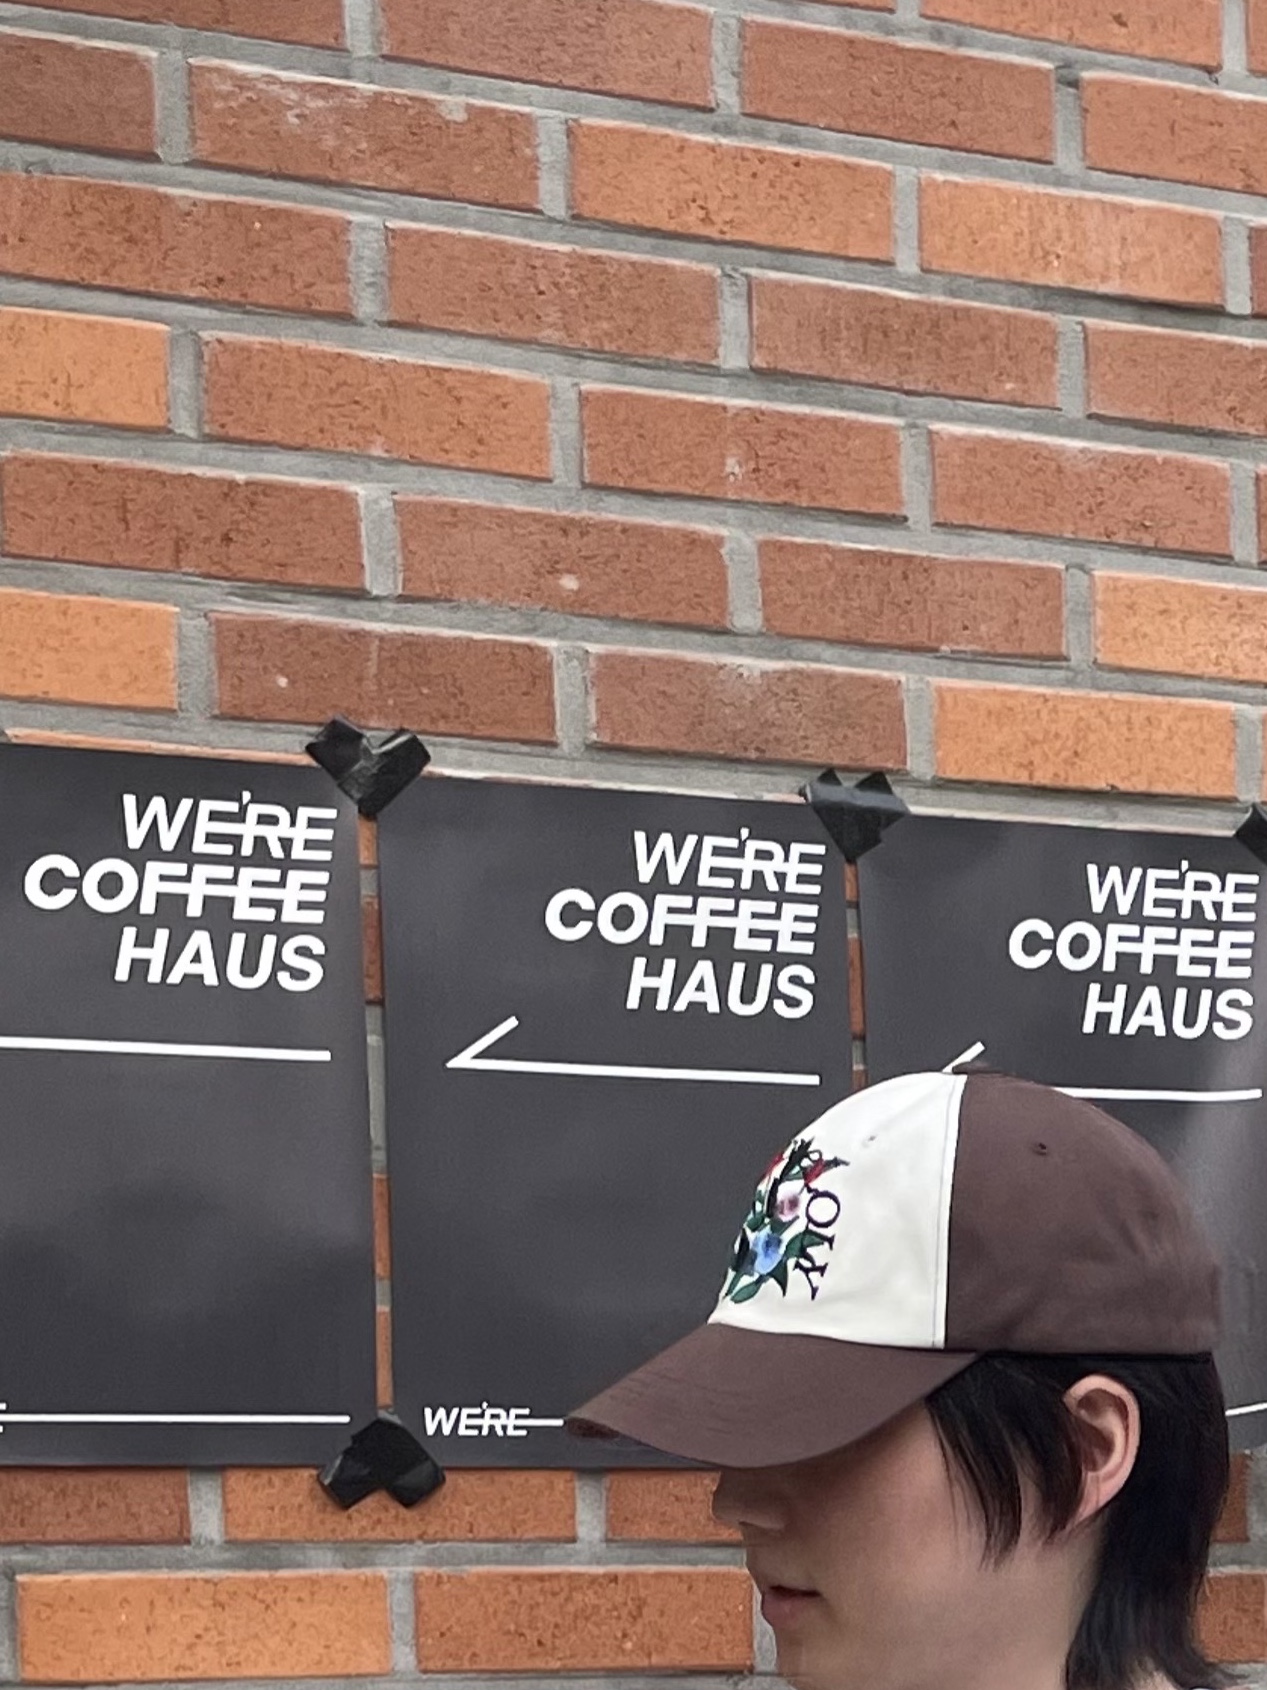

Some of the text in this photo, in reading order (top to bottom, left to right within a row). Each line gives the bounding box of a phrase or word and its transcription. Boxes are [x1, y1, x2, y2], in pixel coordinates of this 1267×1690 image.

[122, 790, 338, 862] WE'RE
[24, 854, 330, 924] COFFEE
[633, 827, 826, 895] WE'RE
[1086, 859, 1260, 923] WE'RE
[544, 887, 820, 955] COFFEE
[1008, 918, 1255, 979] COFFEE
[114, 926, 326, 992] HAUS
[626, 956, 816, 1019] HAUS
[1082, 982, 1254, 1041] HAUS
